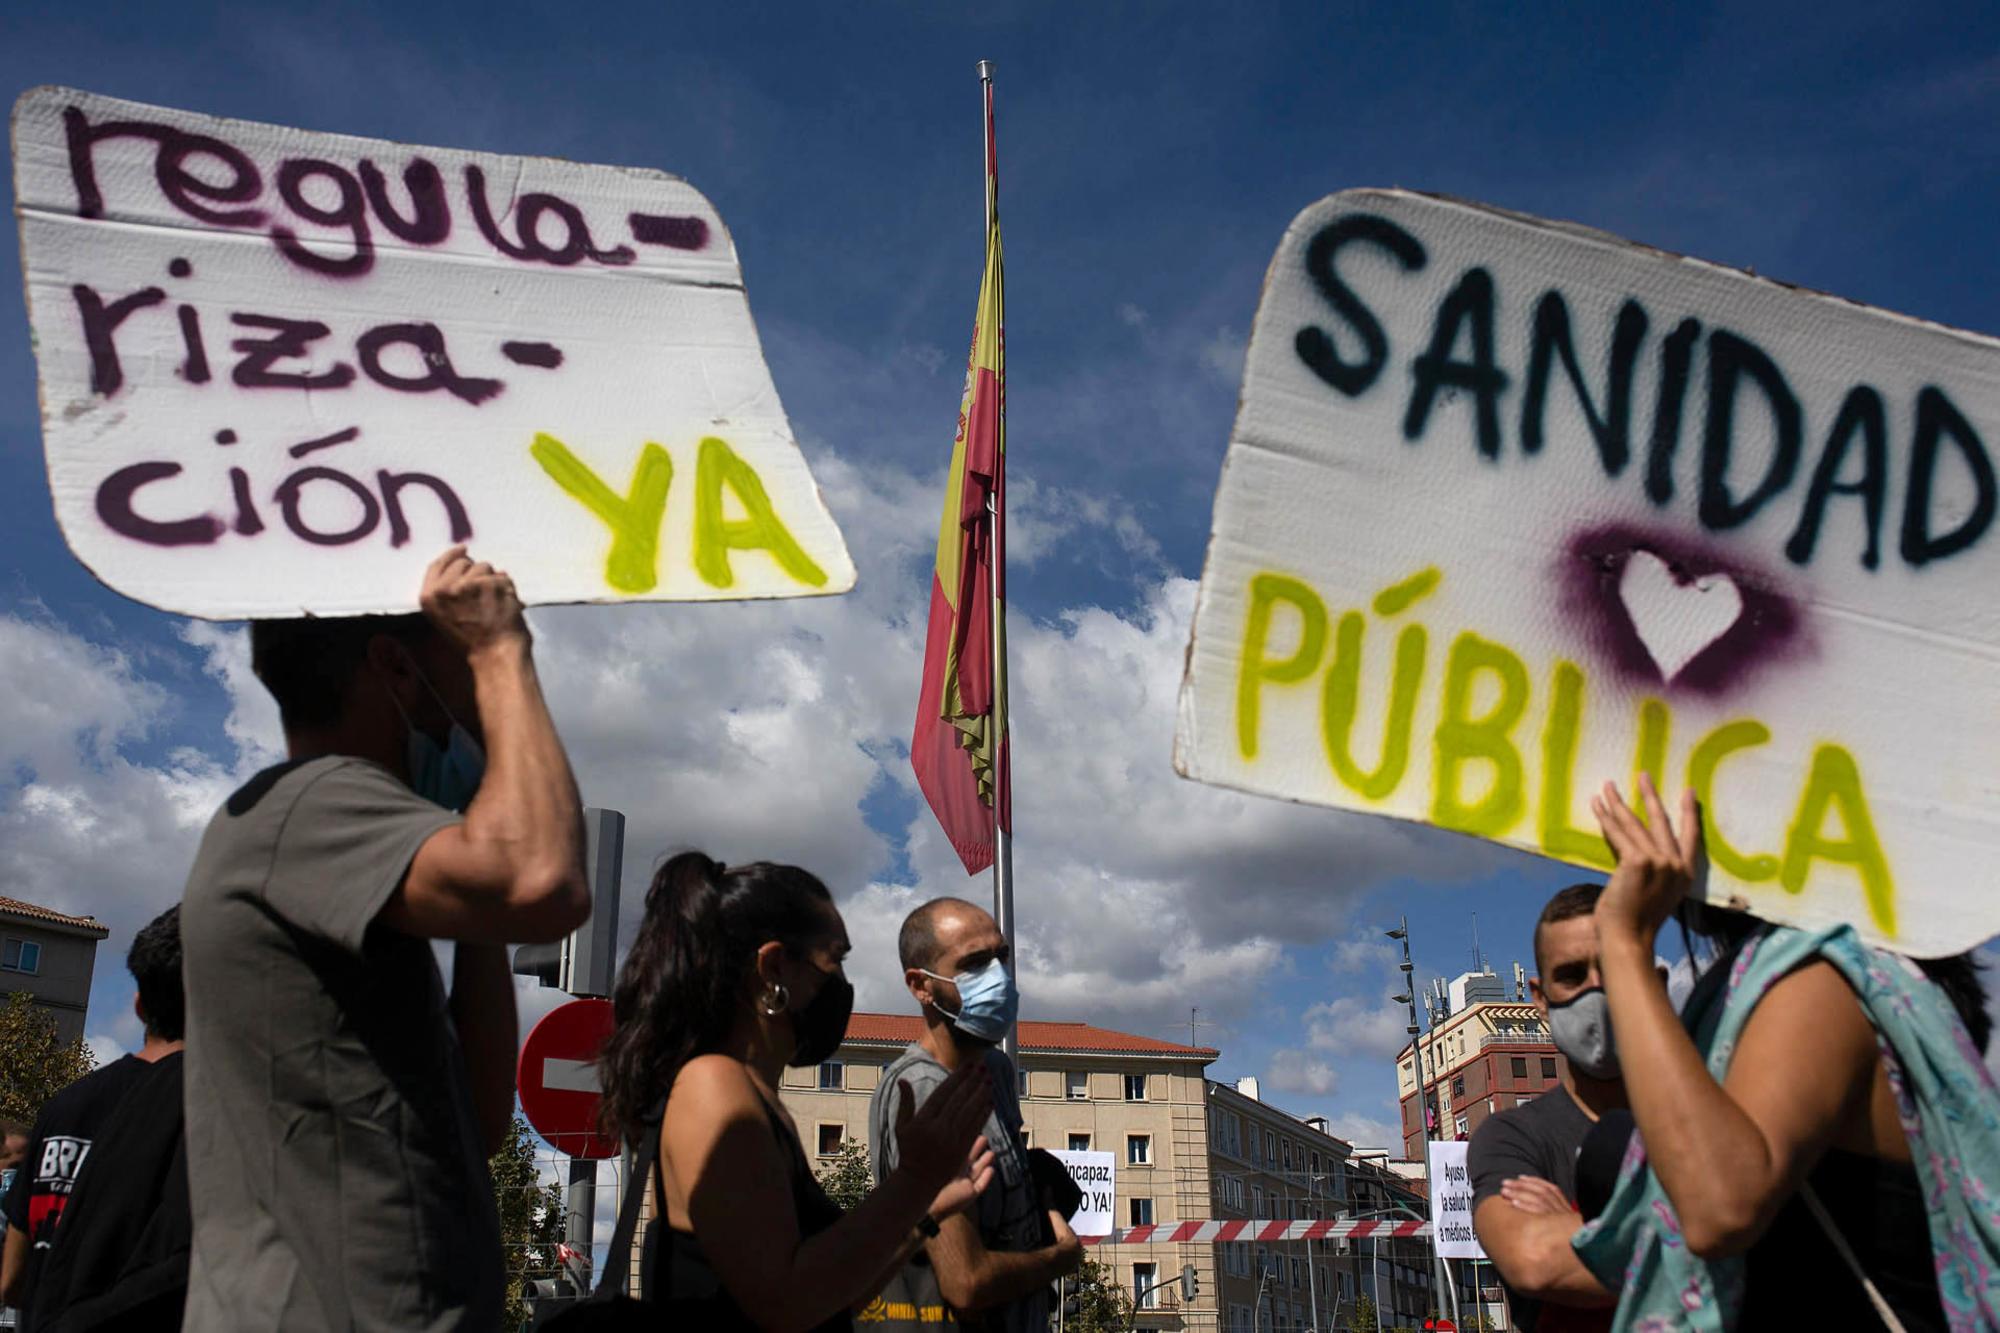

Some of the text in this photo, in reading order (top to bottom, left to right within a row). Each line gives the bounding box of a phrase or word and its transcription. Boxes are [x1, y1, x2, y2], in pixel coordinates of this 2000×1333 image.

[62, 104, 711, 279] regula-
[71, 256, 565, 406] riza-
[1294, 212, 1999, 572] SANIDAD
[96, 427, 830, 595] ción YA
[1236, 565, 1900, 940] PÚBLICA
[1092, 1191, 1112, 1212] YA!
[1444, 1161, 1465, 1186] Ayuso
[1445, 1221, 1472, 1242] médicos
[1449, 1191, 1466, 1211] salud
